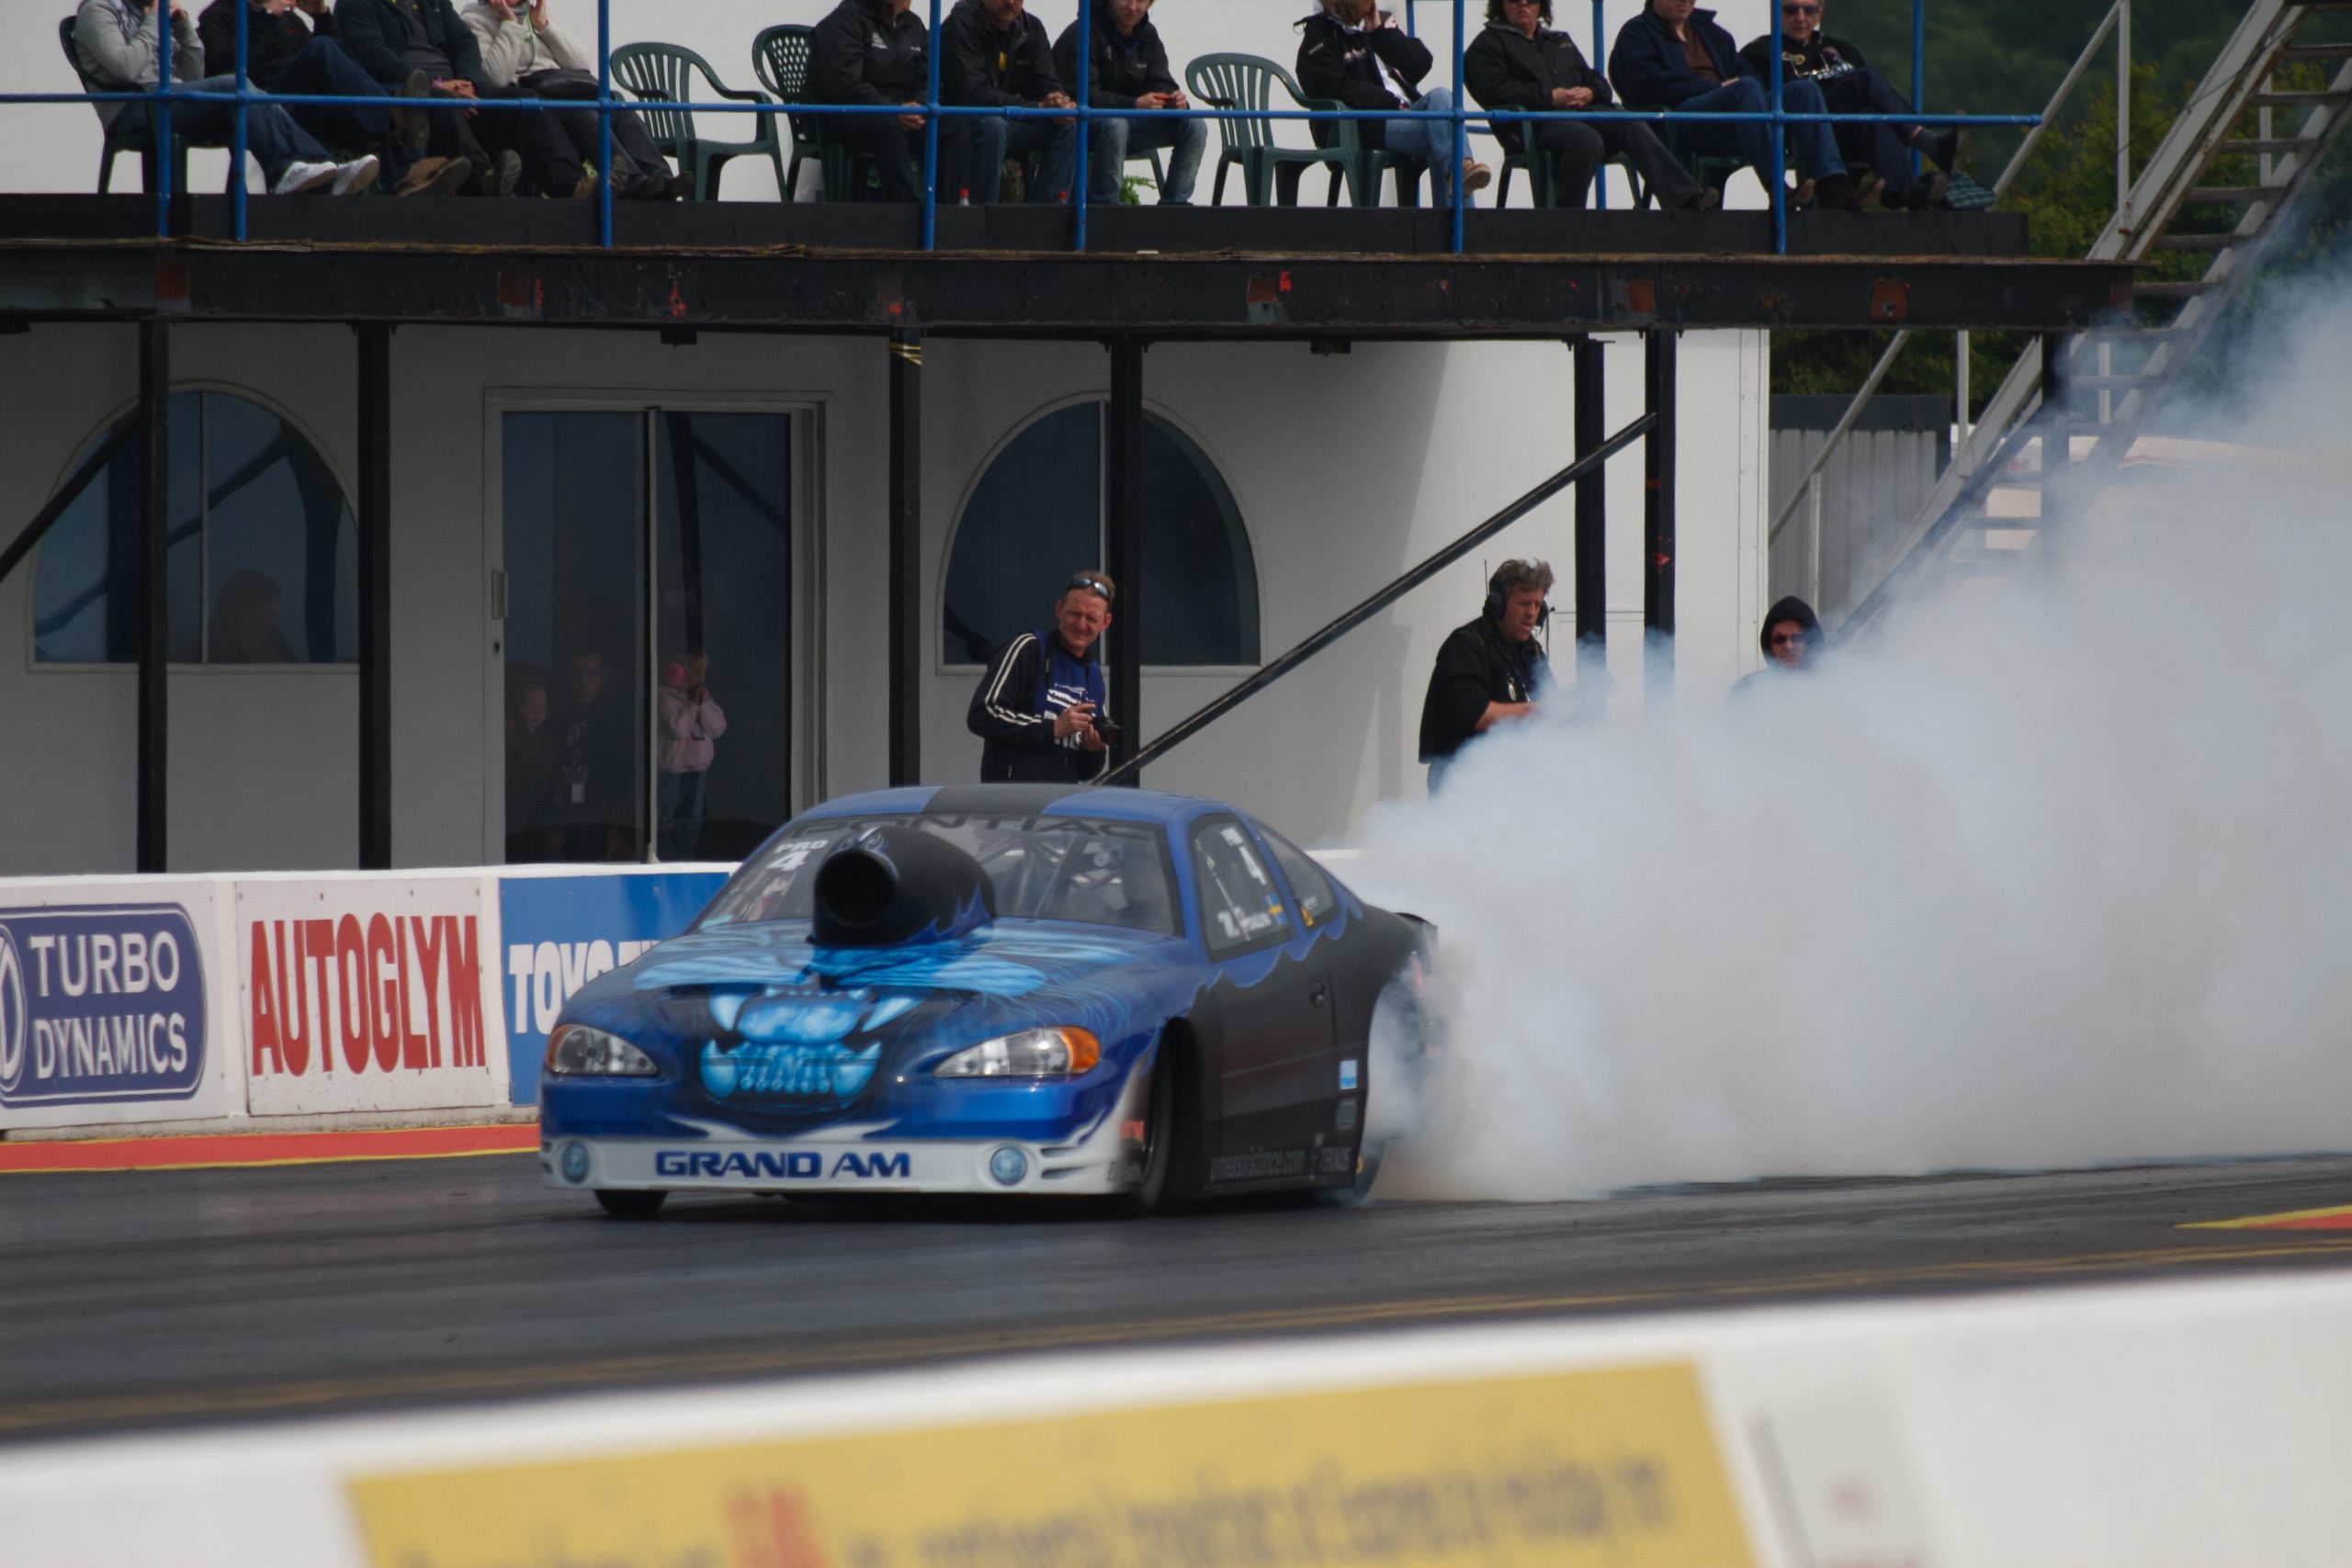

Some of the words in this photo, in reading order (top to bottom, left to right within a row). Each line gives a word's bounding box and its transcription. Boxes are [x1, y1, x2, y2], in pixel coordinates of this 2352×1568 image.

[766, 851, 809, 872] 4
[774, 840, 829, 854] PRO
[29, 931, 180, 998] TURBO
[251, 912, 486, 1077] AUTOGLYM
[509, 939, 662, 1035] TOY
[34, 1012, 187, 1079] DYNAMICS
[655, 1151, 822, 1179] GRAND
[830, 1152, 910, 1179] AM
